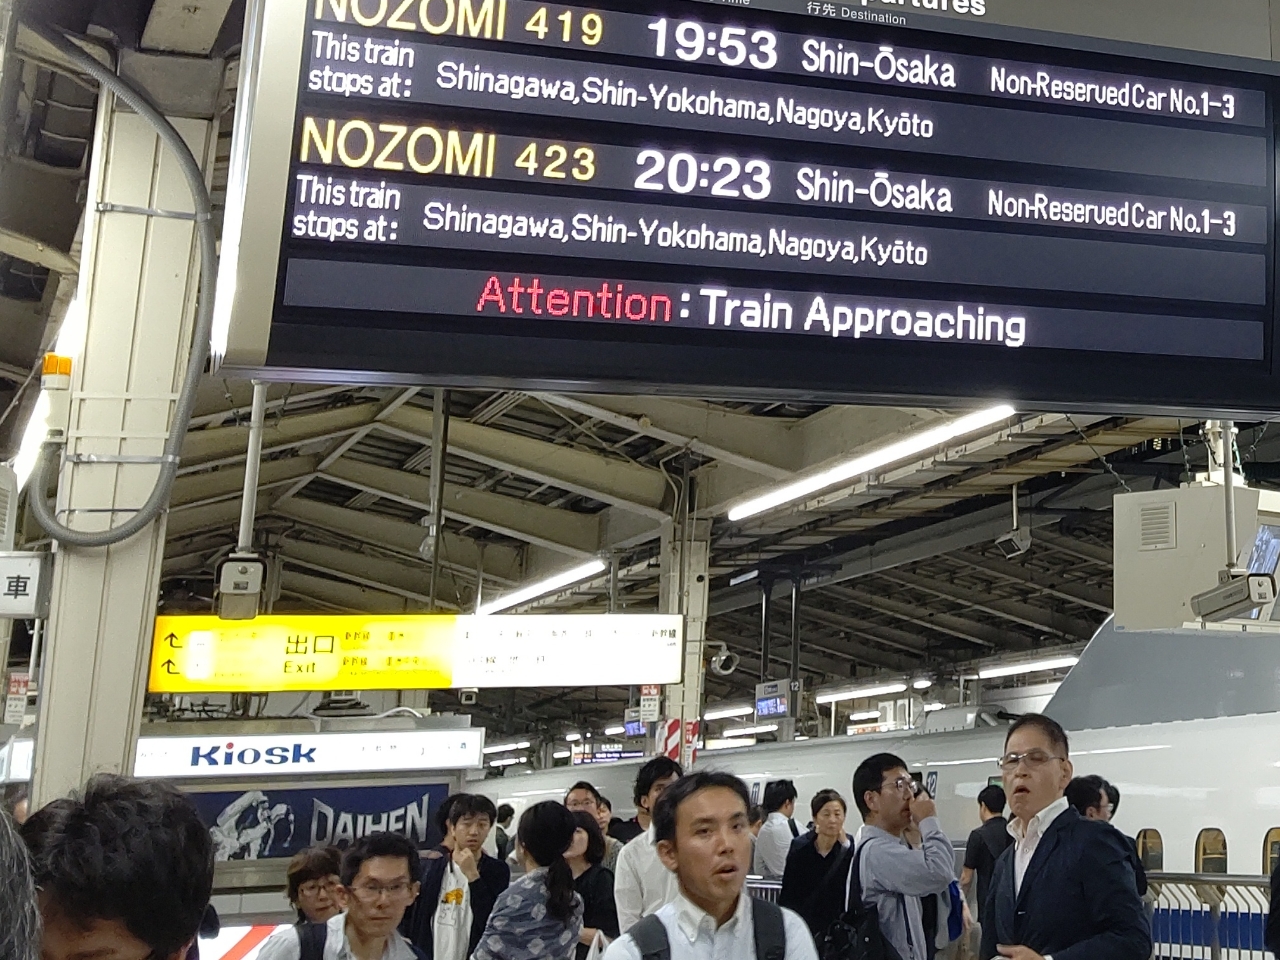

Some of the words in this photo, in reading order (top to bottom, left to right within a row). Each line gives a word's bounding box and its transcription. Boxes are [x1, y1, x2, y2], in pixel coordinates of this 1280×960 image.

[806, 1, 837, 17] 行先
[840, 7, 907, 26] Destination
[312, 29, 364, 62] This
[364, 39, 415, 68] train
[525, 12, 604, 47] 419
[647, 17, 779, 70] 19:53
[801, 38, 956, 89] Shin-Ōsaka
[308, 65, 373, 97] stops
[379, 73, 412, 98] at:
[301, 117, 496, 178] NOZOMI
[514, 142, 596, 182] 423
[634, 149, 772, 200] 20:23
[795, 166, 954, 213] Shin-Ōsaka
[296, 174, 345, 206] This
[349, 180, 401, 211] train
[293, 210, 359, 242] stops
[365, 216, 398, 242] at:
[700, 288, 793, 330] Train
[802, 296, 1026, 347] Approaching
[3, 574, 31, 600] 車
[285, 634, 335, 655] 出口
[283, 660, 317, 674] Exit
[790, 681, 799, 691] 12
[190, 742, 317, 767] Kiosk
[928, 774, 937, 797] 12
